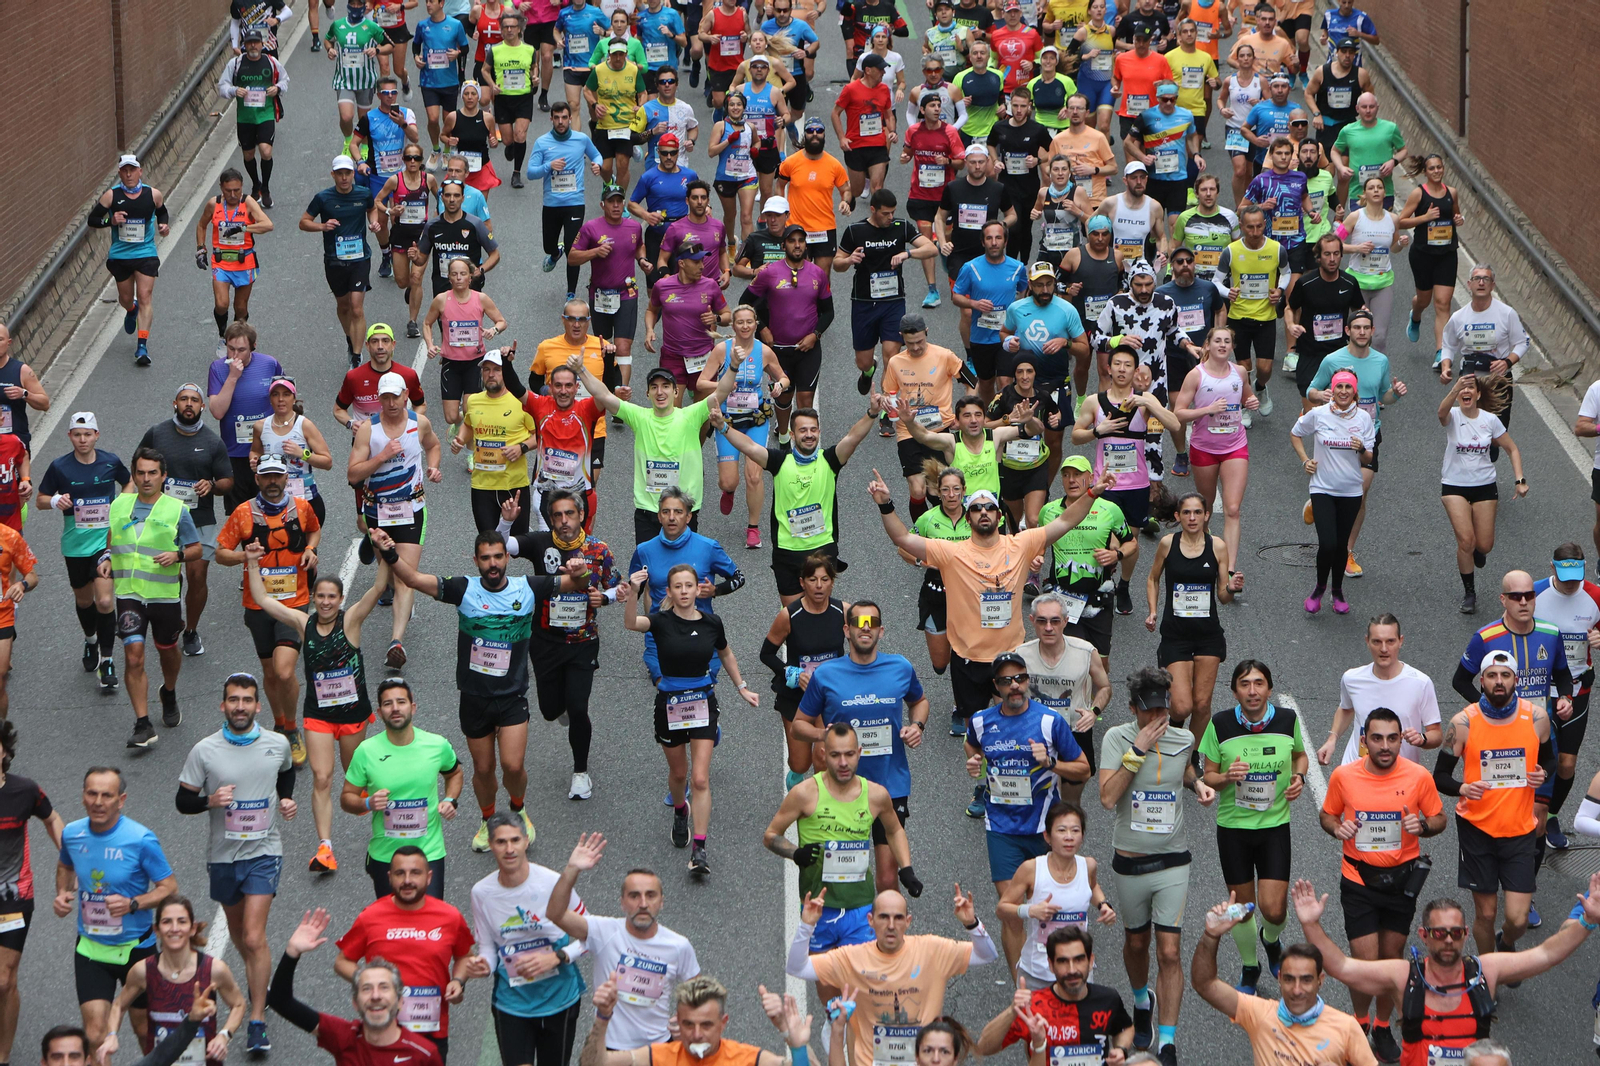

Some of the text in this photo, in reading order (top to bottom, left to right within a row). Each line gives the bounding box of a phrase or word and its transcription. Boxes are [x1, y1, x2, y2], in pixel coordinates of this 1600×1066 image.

[434, 241, 469, 252] Playtika
[866, 239, 897, 248] Daralux
[475, 427, 506, 436] SEVILLA
[555, 451, 574, 459] ZURICH
[485, 641, 508, 650] ZURICH
[326, 670, 348, 678] ZURICH
[680, 694, 702, 702] ZURICH
[240, 799, 265, 808] ZURICH
[105, 848, 123, 861] ITA
[386, 930, 426, 940] OZONO
[518, 940, 544, 950] ZURICH
[637, 961, 663, 972] ZURICH
[633, 975, 650, 985] 7393
[1090, 1010, 1111, 1031] SOY
[1068, 1046, 1096, 1054] ZURICH
